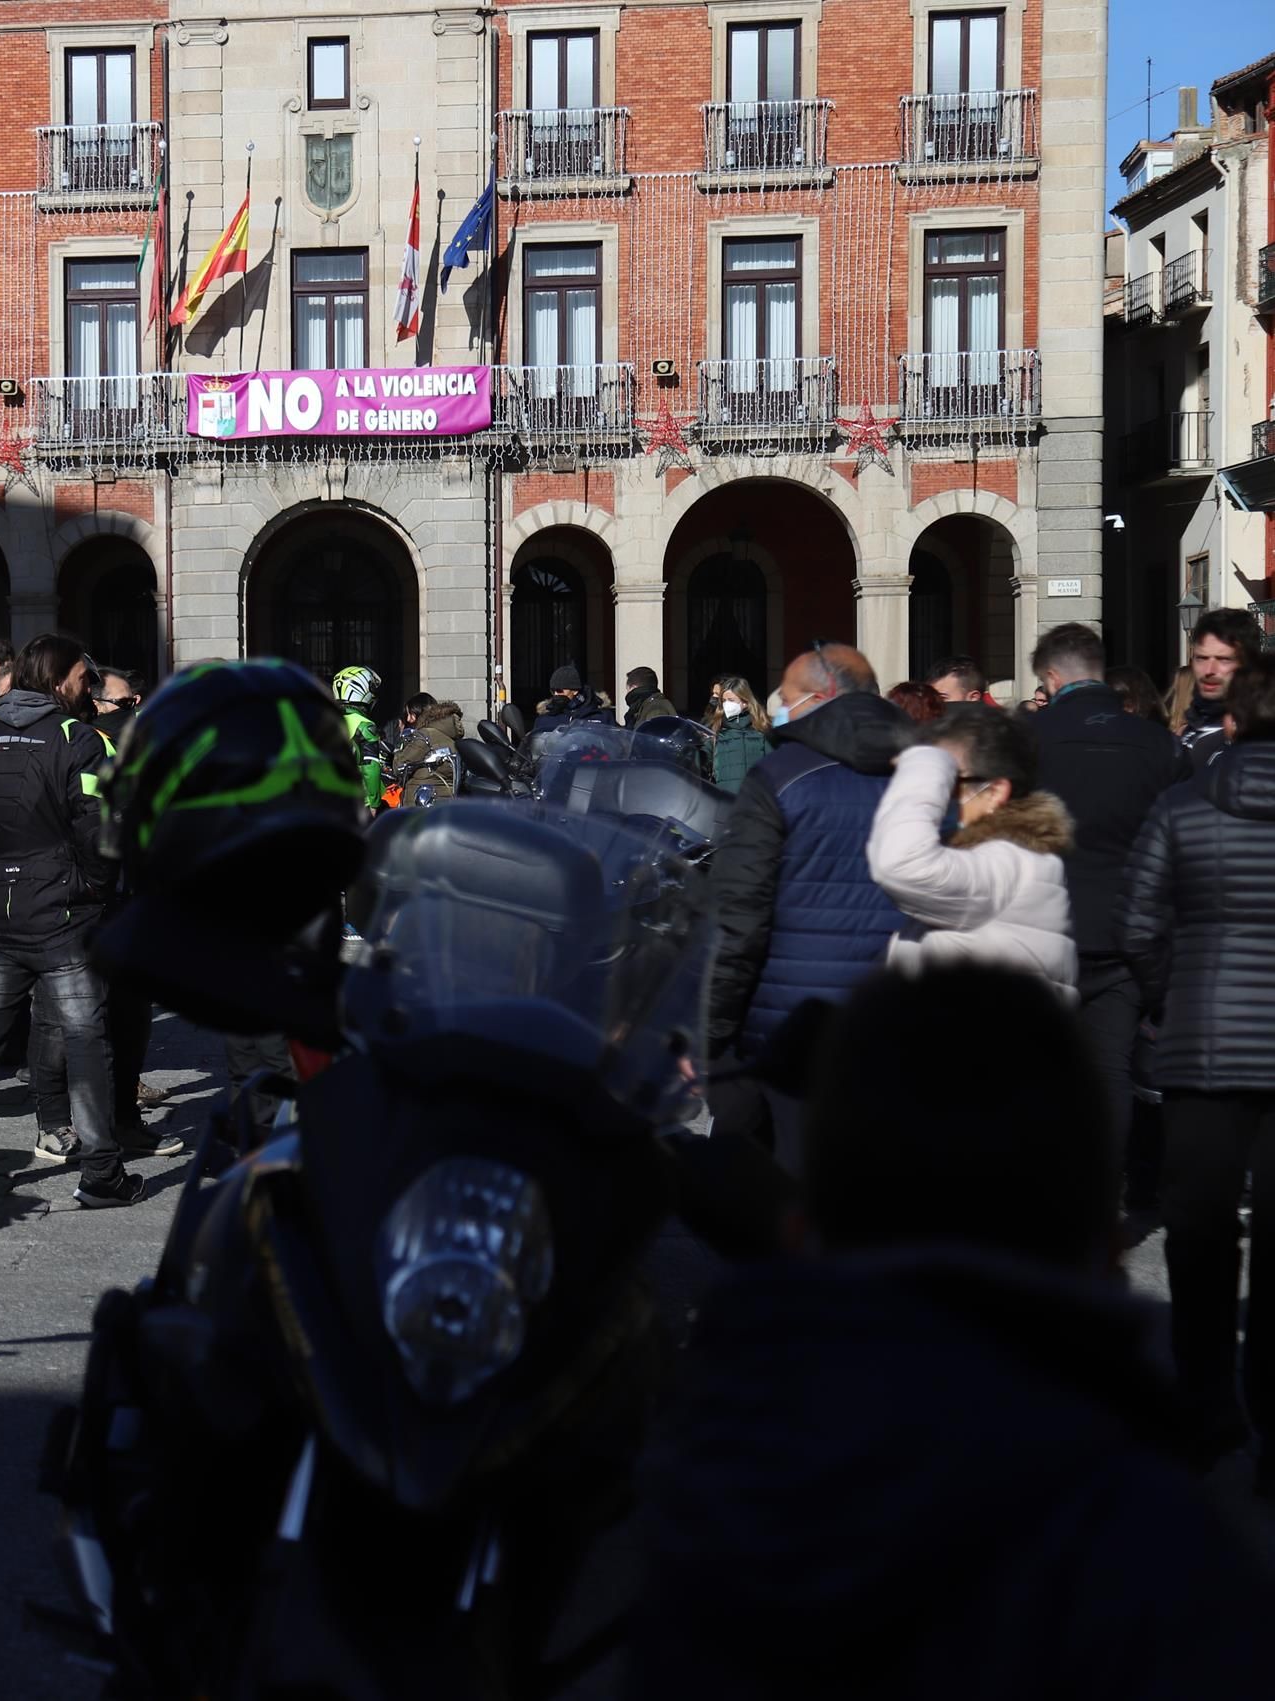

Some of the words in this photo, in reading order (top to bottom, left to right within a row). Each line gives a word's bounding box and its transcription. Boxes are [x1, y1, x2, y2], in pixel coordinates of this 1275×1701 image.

[335, 377, 349, 398] A
[354, 376, 377, 398] LA
[379, 373, 477, 397] VIOLENCIA
[247, 376, 323, 432] NO
[335, 409, 359, 431] DE
[364, 403, 438, 431] GÉNERO
